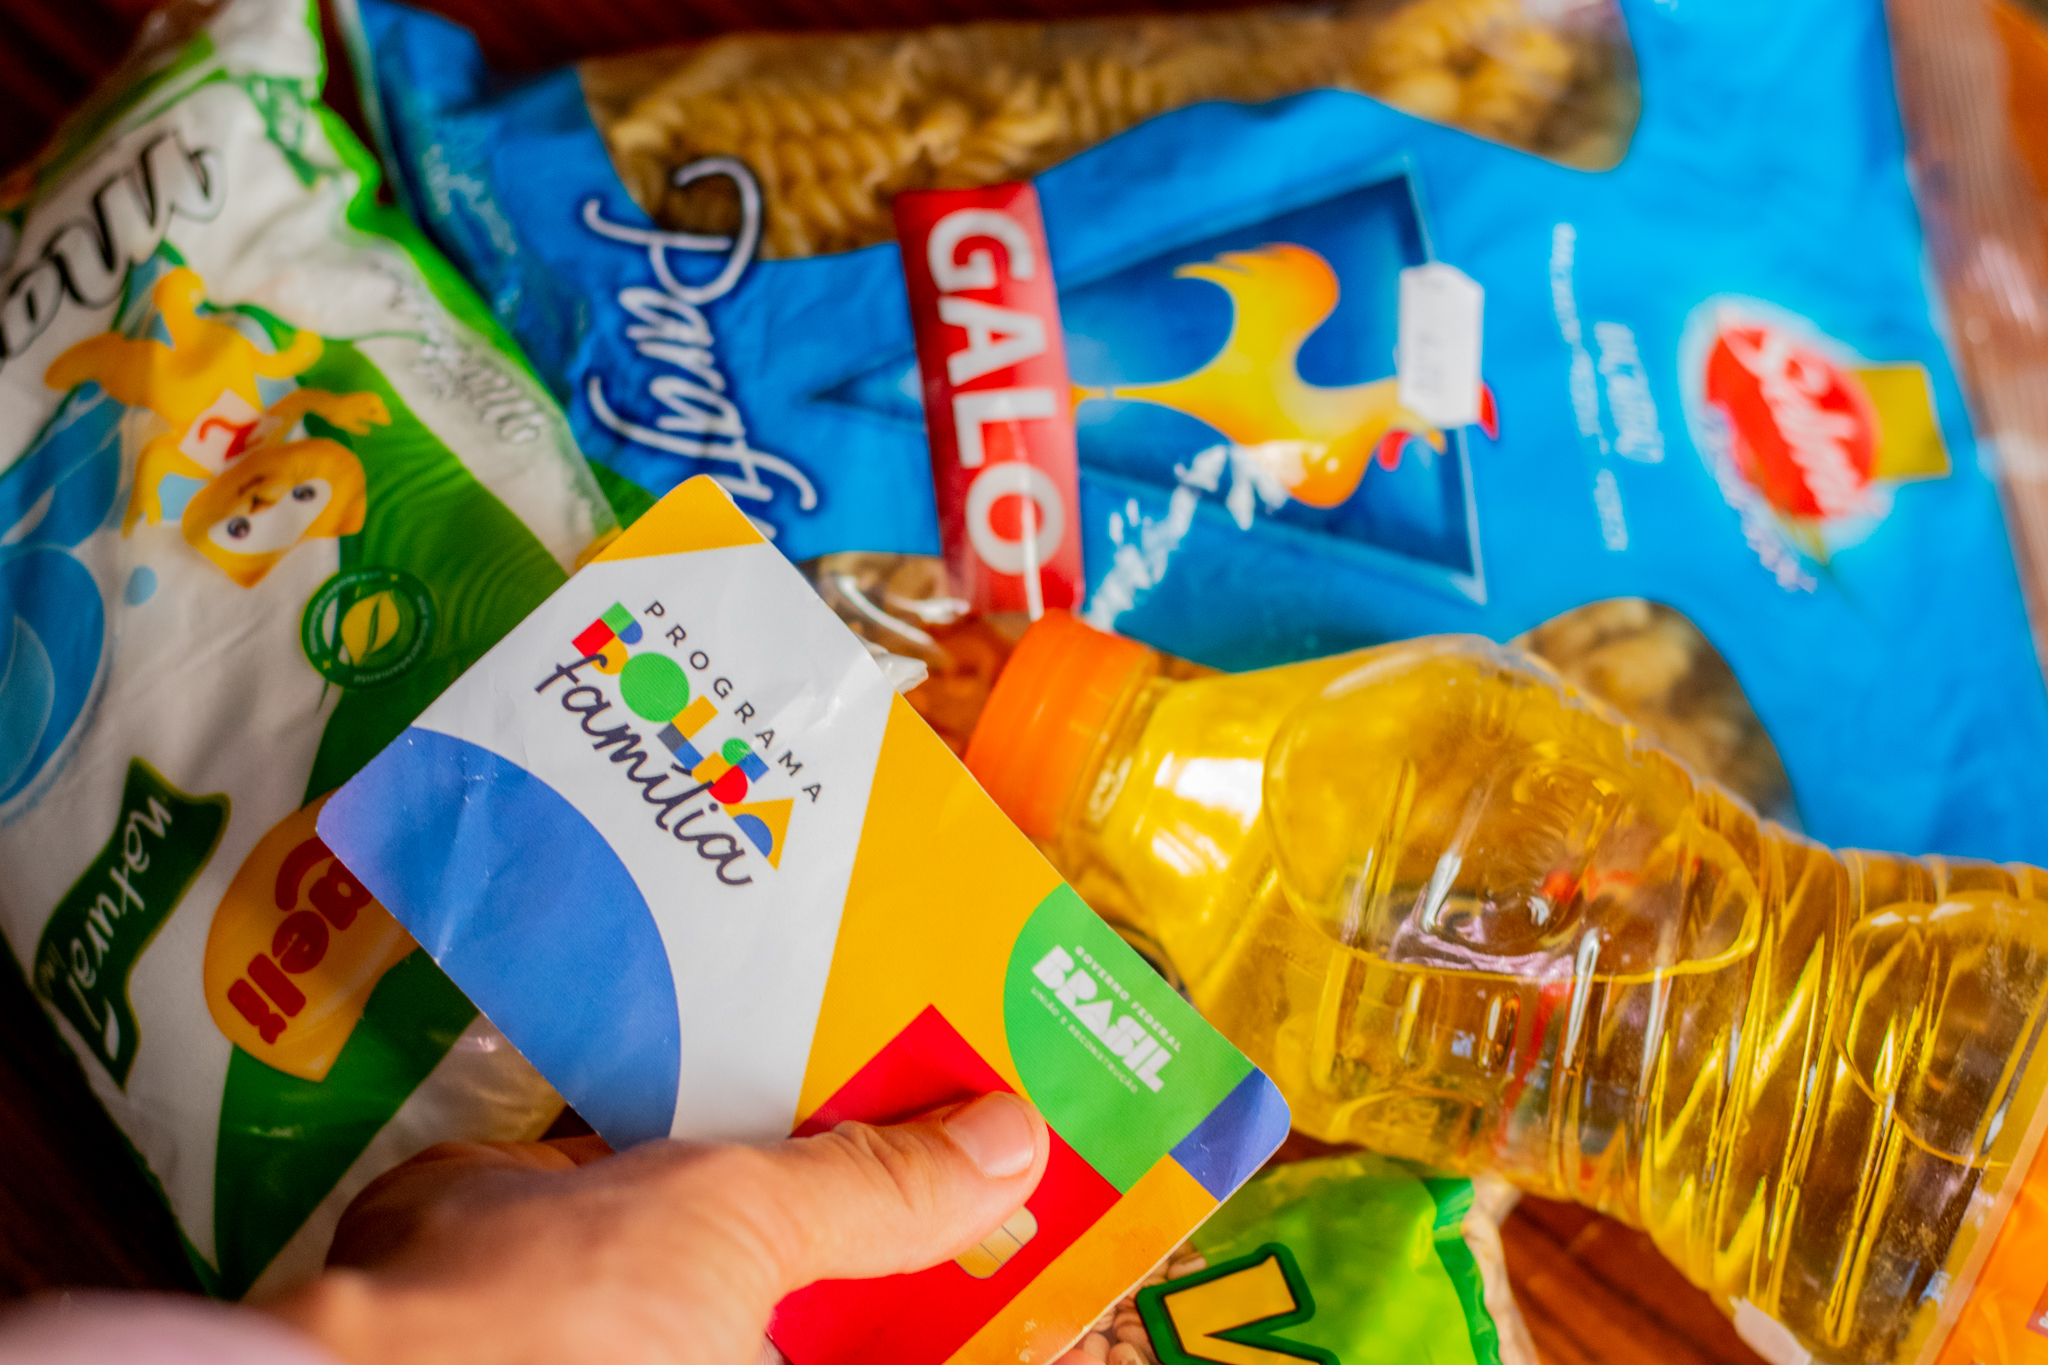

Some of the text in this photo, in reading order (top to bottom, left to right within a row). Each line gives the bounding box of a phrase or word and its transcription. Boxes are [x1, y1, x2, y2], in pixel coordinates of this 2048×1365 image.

[926, 209, 1065, 575] GALO
[534, 653, 753, 886] família
[571, 601, 794, 871] BOLSA
[644, 601, 823, 803] PROGRAMA
[69, 796, 173, 1034] natural
[1031, 944, 1172, 1093] BRASIL
[1074, 945, 1182, 1052] GOVERNO FEDERAL
